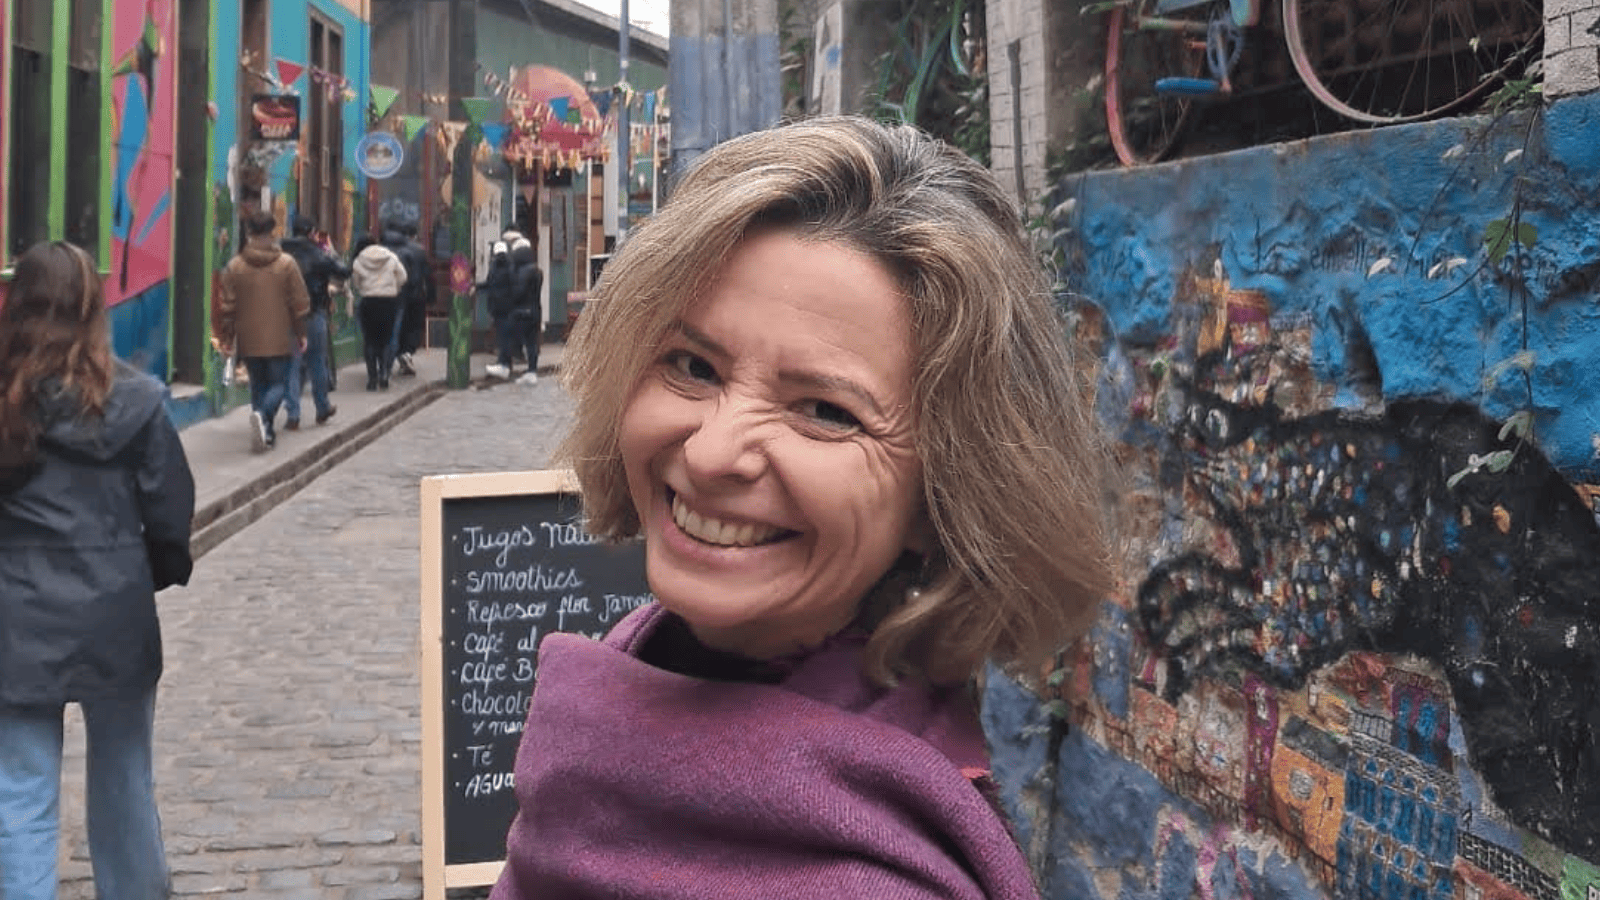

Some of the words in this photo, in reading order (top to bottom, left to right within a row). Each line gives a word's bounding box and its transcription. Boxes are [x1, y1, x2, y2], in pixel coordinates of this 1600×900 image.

[462, 524, 535, 568] Jugos
[556, 593, 592, 631] flor
[463, 631, 505, 663] Café
[517, 625, 537, 651] al
[460, 656, 507, 694] Café
[512, 657, 537, 682] B
[466, 743, 494, 767] Té
